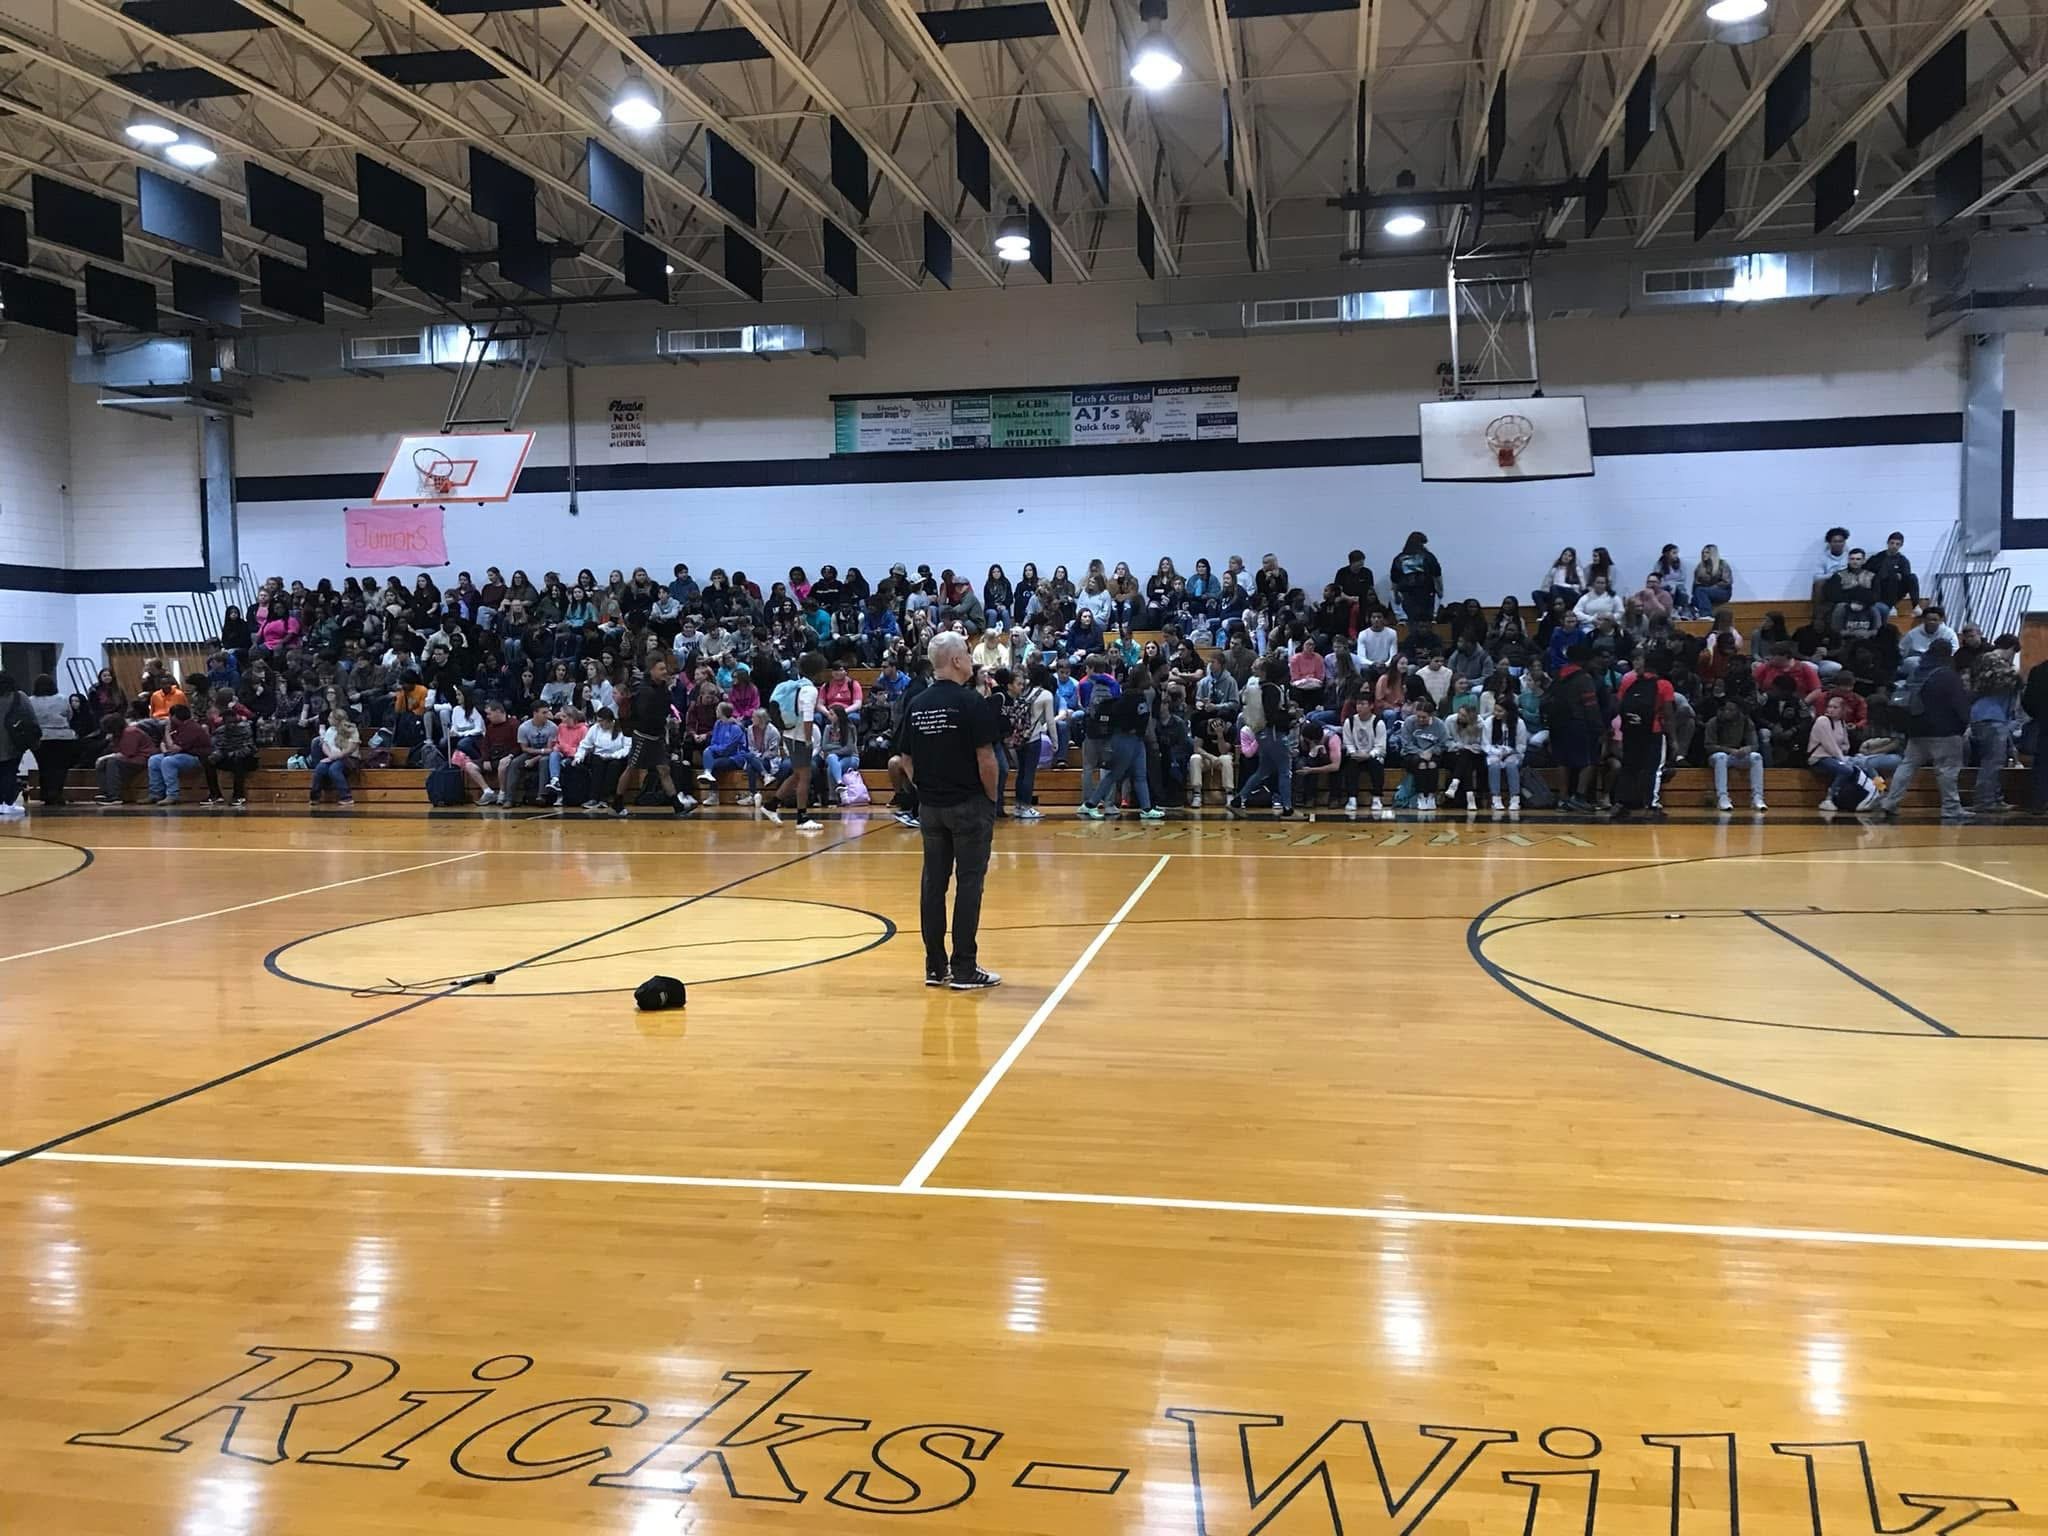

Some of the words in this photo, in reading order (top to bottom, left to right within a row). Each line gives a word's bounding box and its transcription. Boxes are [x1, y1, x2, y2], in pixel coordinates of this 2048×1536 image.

[1157, 386, 1189, 395] BRONZE
[1191, 384, 1233, 393] SPONSORS
[1074, 394, 1096, 403] Catch
[1098, 394, 1106, 402] A
[1108, 393, 1130, 402] Great
[1132, 392, 1151, 401] Deal
[608, 400, 644, 412] Please
[992, 410, 1030, 419] Football
[1033, 410, 1071, 418] Coaches
[1074, 407, 1120, 422] AJ's
[610, 423, 641, 431] SMOKING
[1074, 422, 1099, 432] Quick
[1102, 422, 1121, 432] Stop
[610, 431, 642, 439] DIPPING
[1006, 428, 1053, 438] WILDCAT
[616, 440, 646, 448] CHEWING
[1003, 438, 1061, 447] ATHLETICS
